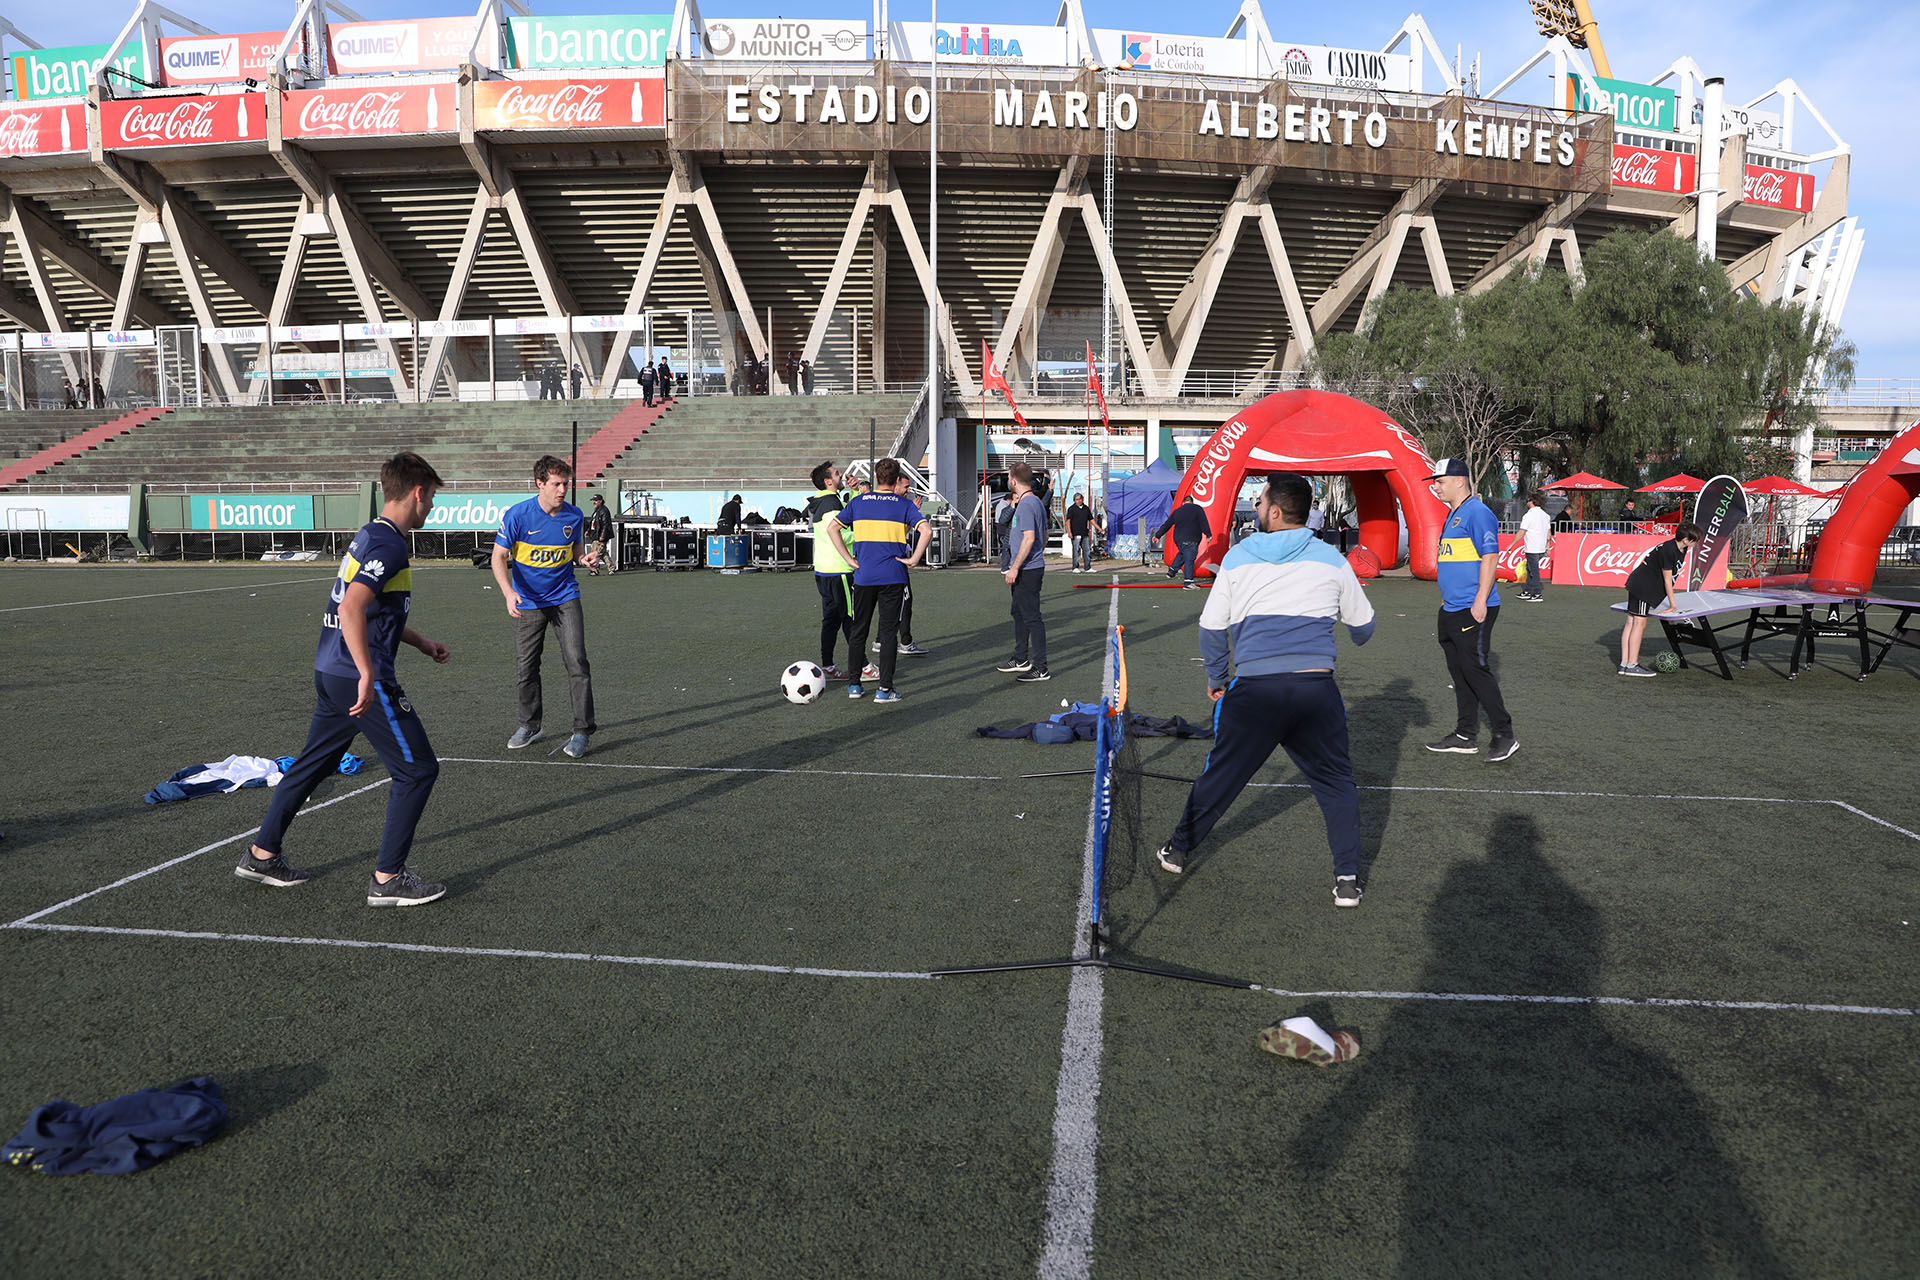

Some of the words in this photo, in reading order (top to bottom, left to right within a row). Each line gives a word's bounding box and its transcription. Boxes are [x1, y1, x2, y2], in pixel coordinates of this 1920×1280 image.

[534, 22, 666, 63] bancor
[753, 23, 810, 39] AUTO
[168, 42, 233, 72] QUIMEX
[250, 45, 259, 56] Y
[337, 29, 408, 62] QUIMEX
[741, 41, 823, 56] MUNICH
[1156, 39, 1204, 58] Lotería
[1154, 58, 1165, 69] de
[1167, 58, 1205, 71] Córdoba
[1280, 60, 1313, 76] ASINOS
[1328, 50, 1387, 81] CASINOS
[1335, 78, 1344, 87] DE
[299, 90, 406, 132] Coca-Cola
[497, 83, 610, 124] Coca-Cola
[120, 100, 219, 142] Coca-Cola
[726, 84, 931, 125] ESTADIO
[994, 88, 1139, 131] MARIO
[1199, 99, 1388, 149] ALBERTO
[1435, 117, 1575, 168] KEMPES
[219, 499, 296, 526] bancor
[1697, 484, 1737, 563] INTERBALL
[530, 549, 567, 563] BBVA
